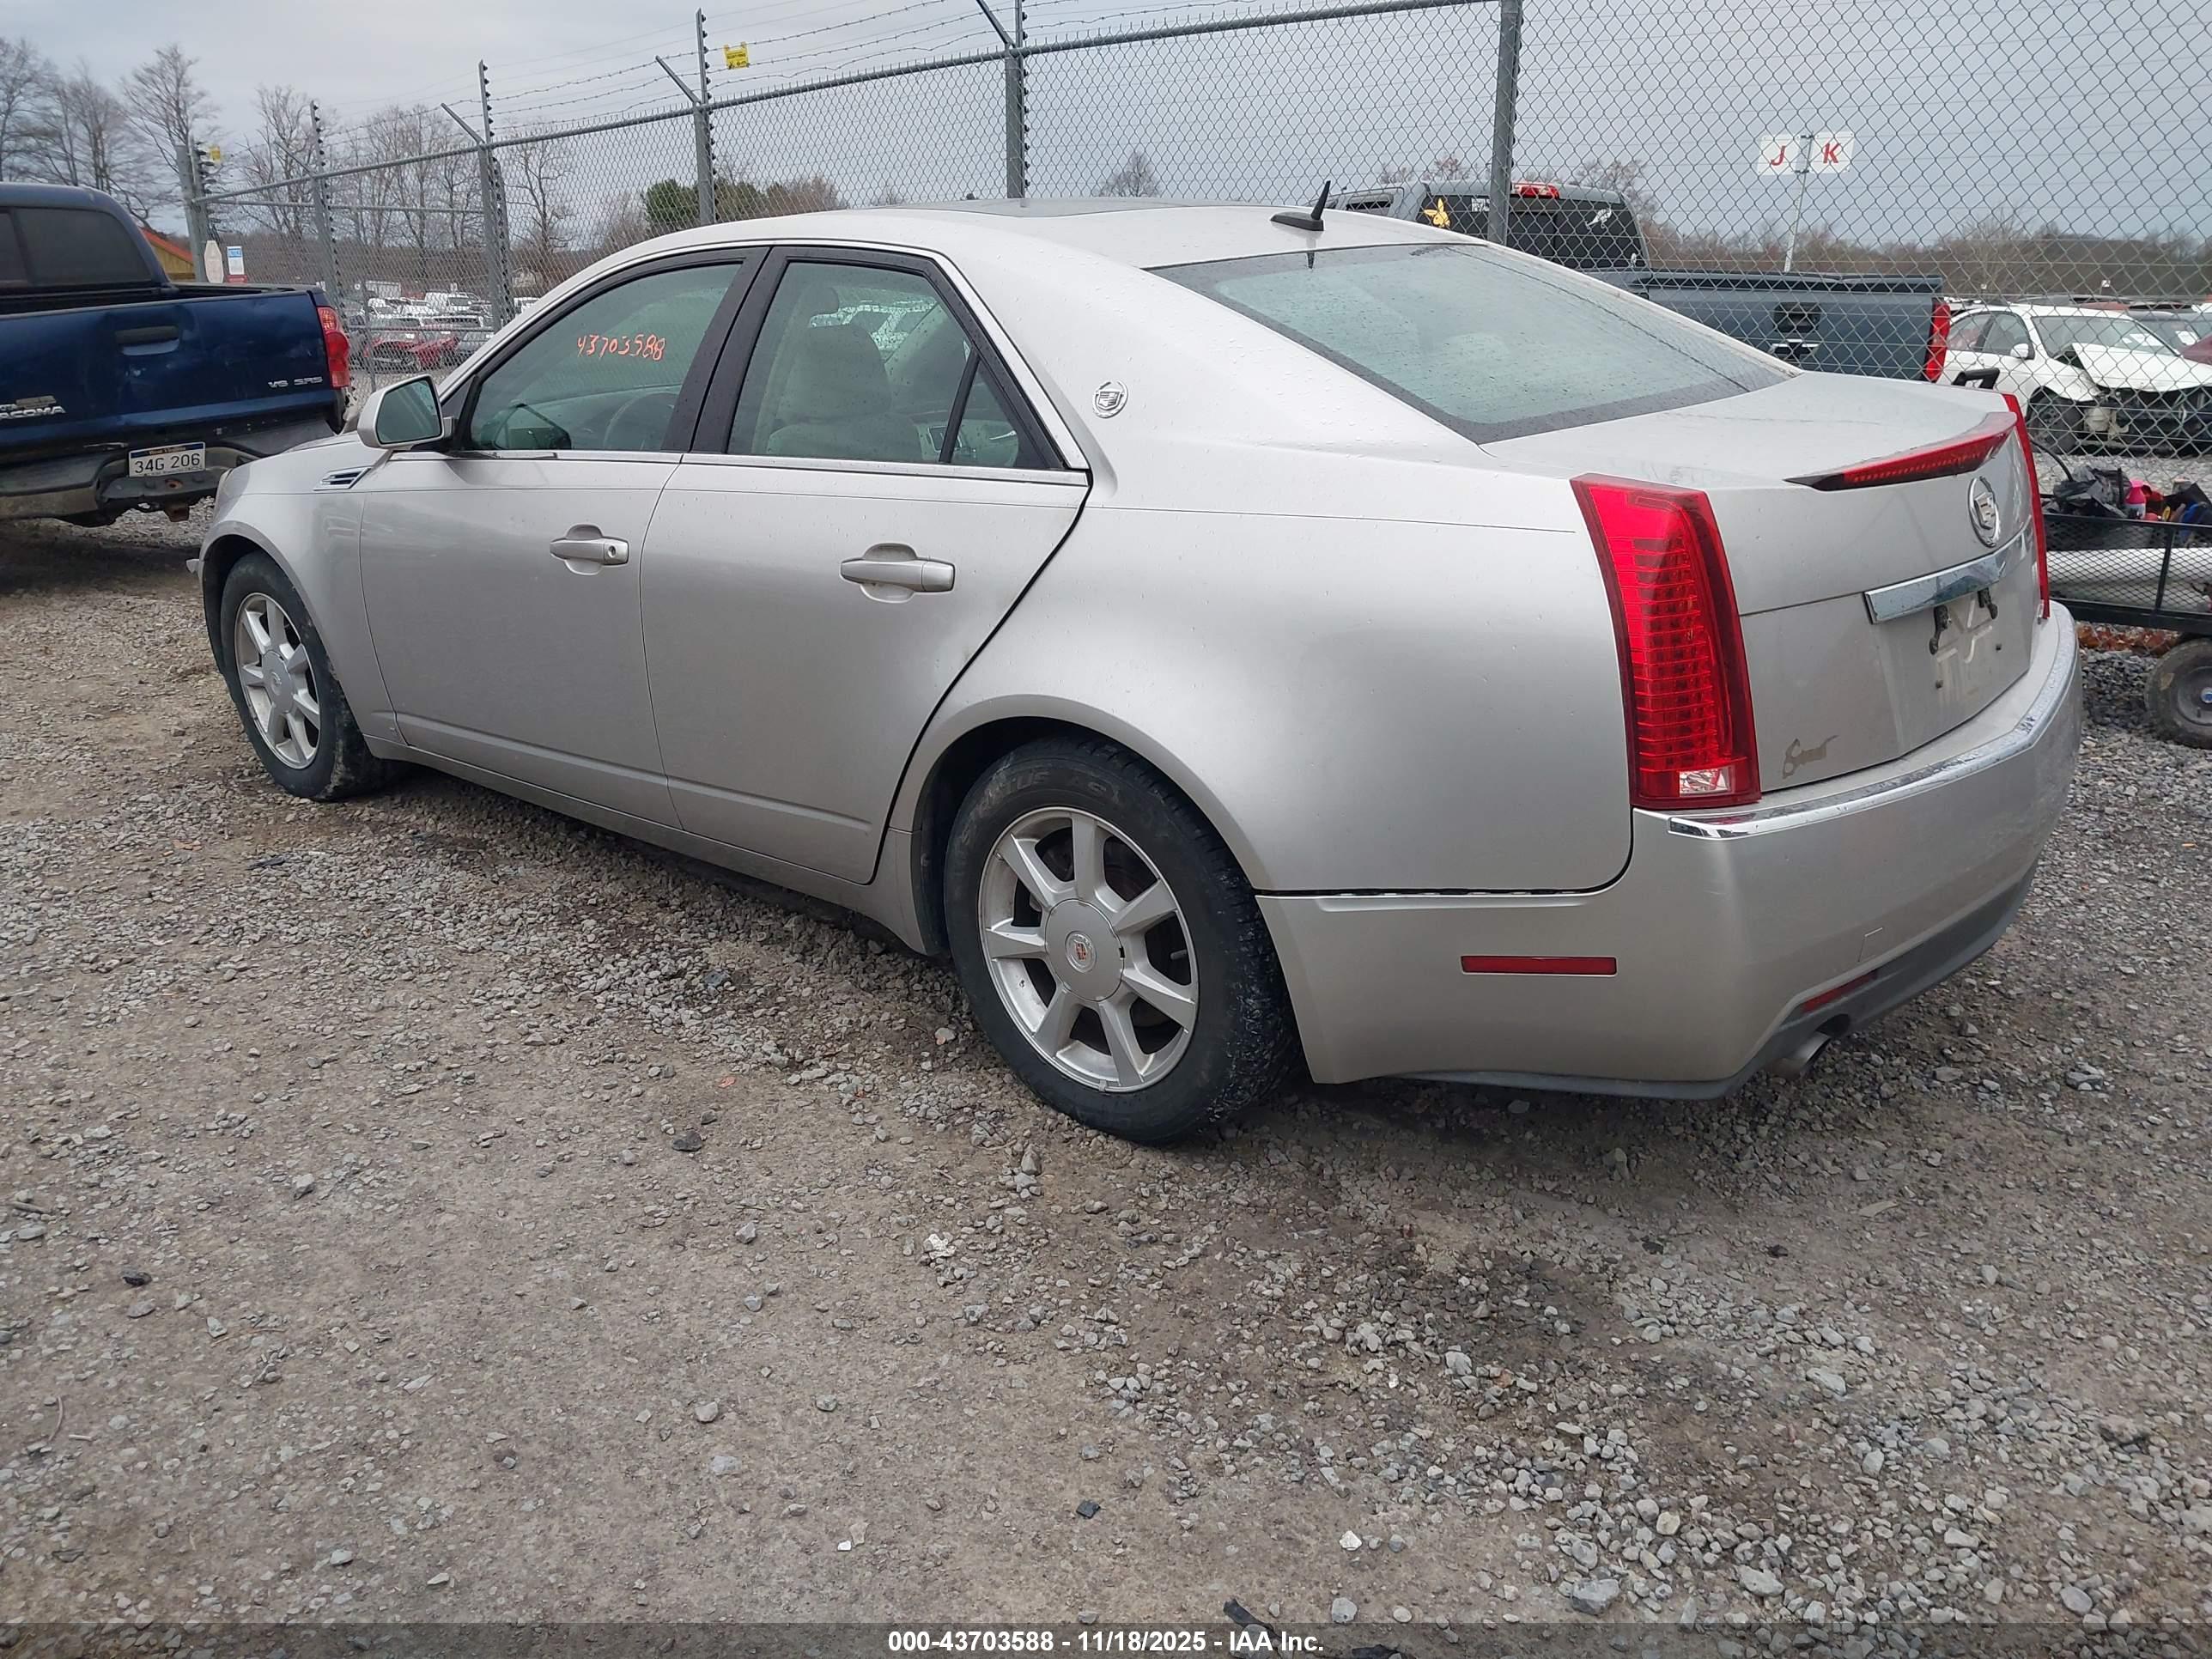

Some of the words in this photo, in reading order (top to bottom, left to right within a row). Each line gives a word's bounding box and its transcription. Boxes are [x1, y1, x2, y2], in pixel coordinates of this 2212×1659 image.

[1771, 145, 1787, 167] J
[1822, 143, 1841, 164] K
[577, 333, 666, 361] 43703588
[0, 405, 66, 420] ACOMA
[134, 457, 165, 474] 34G
[170, 453, 200, 469] 206
